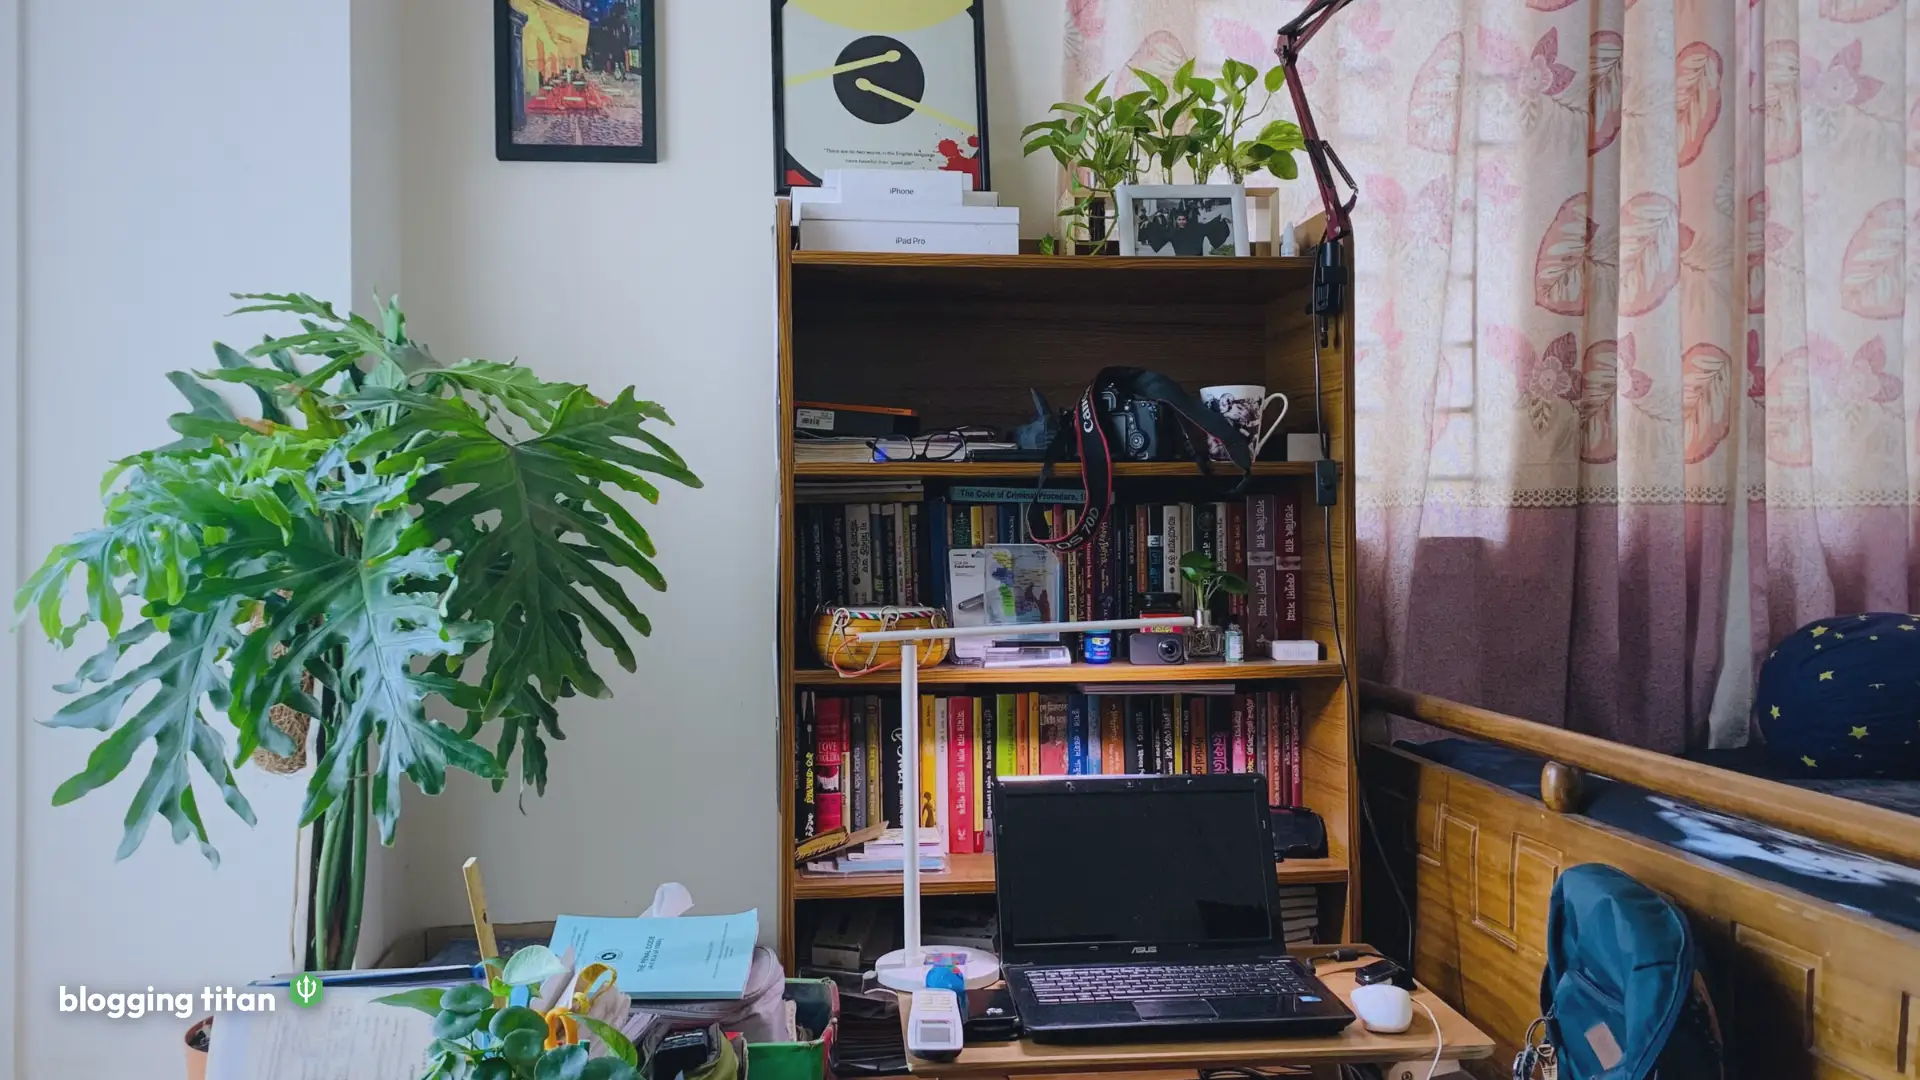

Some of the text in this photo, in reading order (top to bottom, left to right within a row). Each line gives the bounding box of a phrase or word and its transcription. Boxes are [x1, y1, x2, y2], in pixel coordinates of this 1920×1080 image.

[960, 489, 973, 498] The
[976, 490, 995, 498] Code
[997, 490, 1004, 498] of
[1256, 500, 1268, 532] সত্যজিৎ
[1056, 506, 1099, 550] OS 70D
[1256, 534, 1266, 548] রায়
[1284, 504, 1297, 622] সত্যজিৎ রায় ফেলুদা সমগ্র
[1255, 568, 1267, 595] ফেলুদা
[1258, 597, 1267, 616] সমগ্র
[819, 741, 836, 753] LOVE
[1192, 737, 1204, 765] Mystical
[957, 772, 965, 792] ওরহান
[956, 795, 966, 814] পামুক
[641, 949, 651, 964] PENAL
[646, 935, 655, 950] CODE
